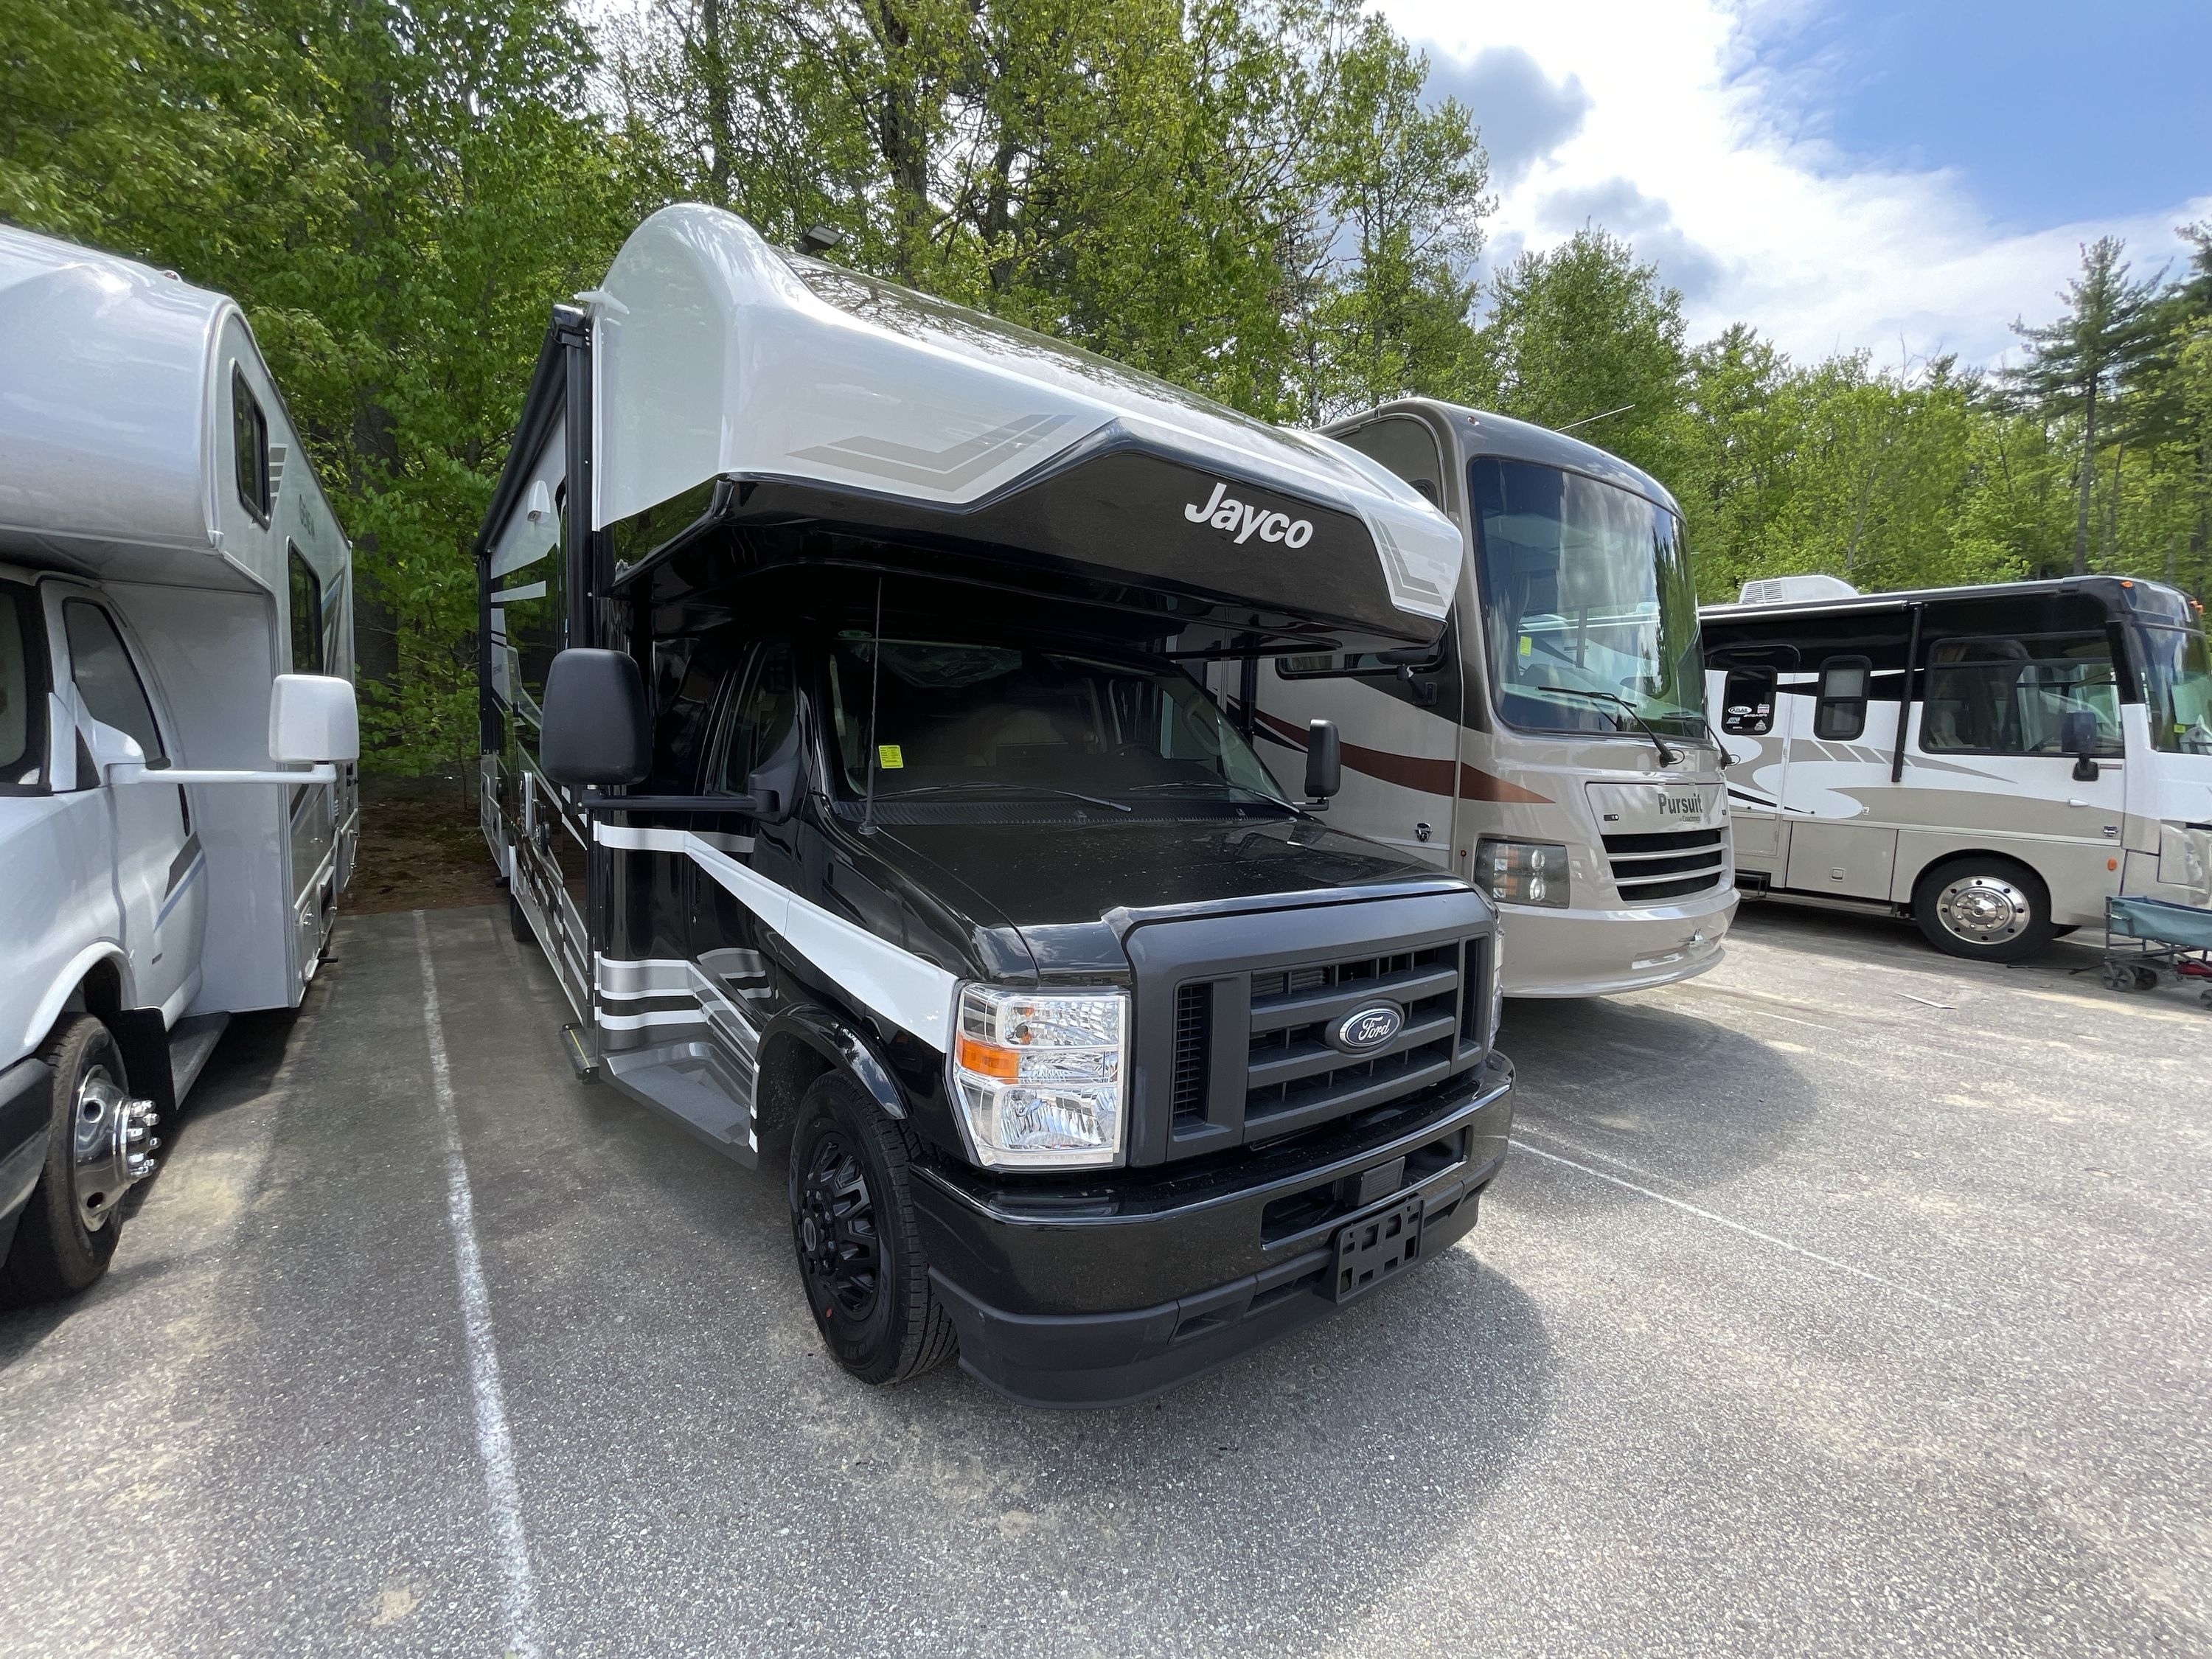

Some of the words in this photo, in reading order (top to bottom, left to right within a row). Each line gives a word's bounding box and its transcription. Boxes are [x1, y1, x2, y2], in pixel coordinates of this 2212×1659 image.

[1184, 482, 1313, 549] Jayco
[1658, 793, 1703, 815] Pursuit
[1358, 1015, 1391, 1041] Ford
